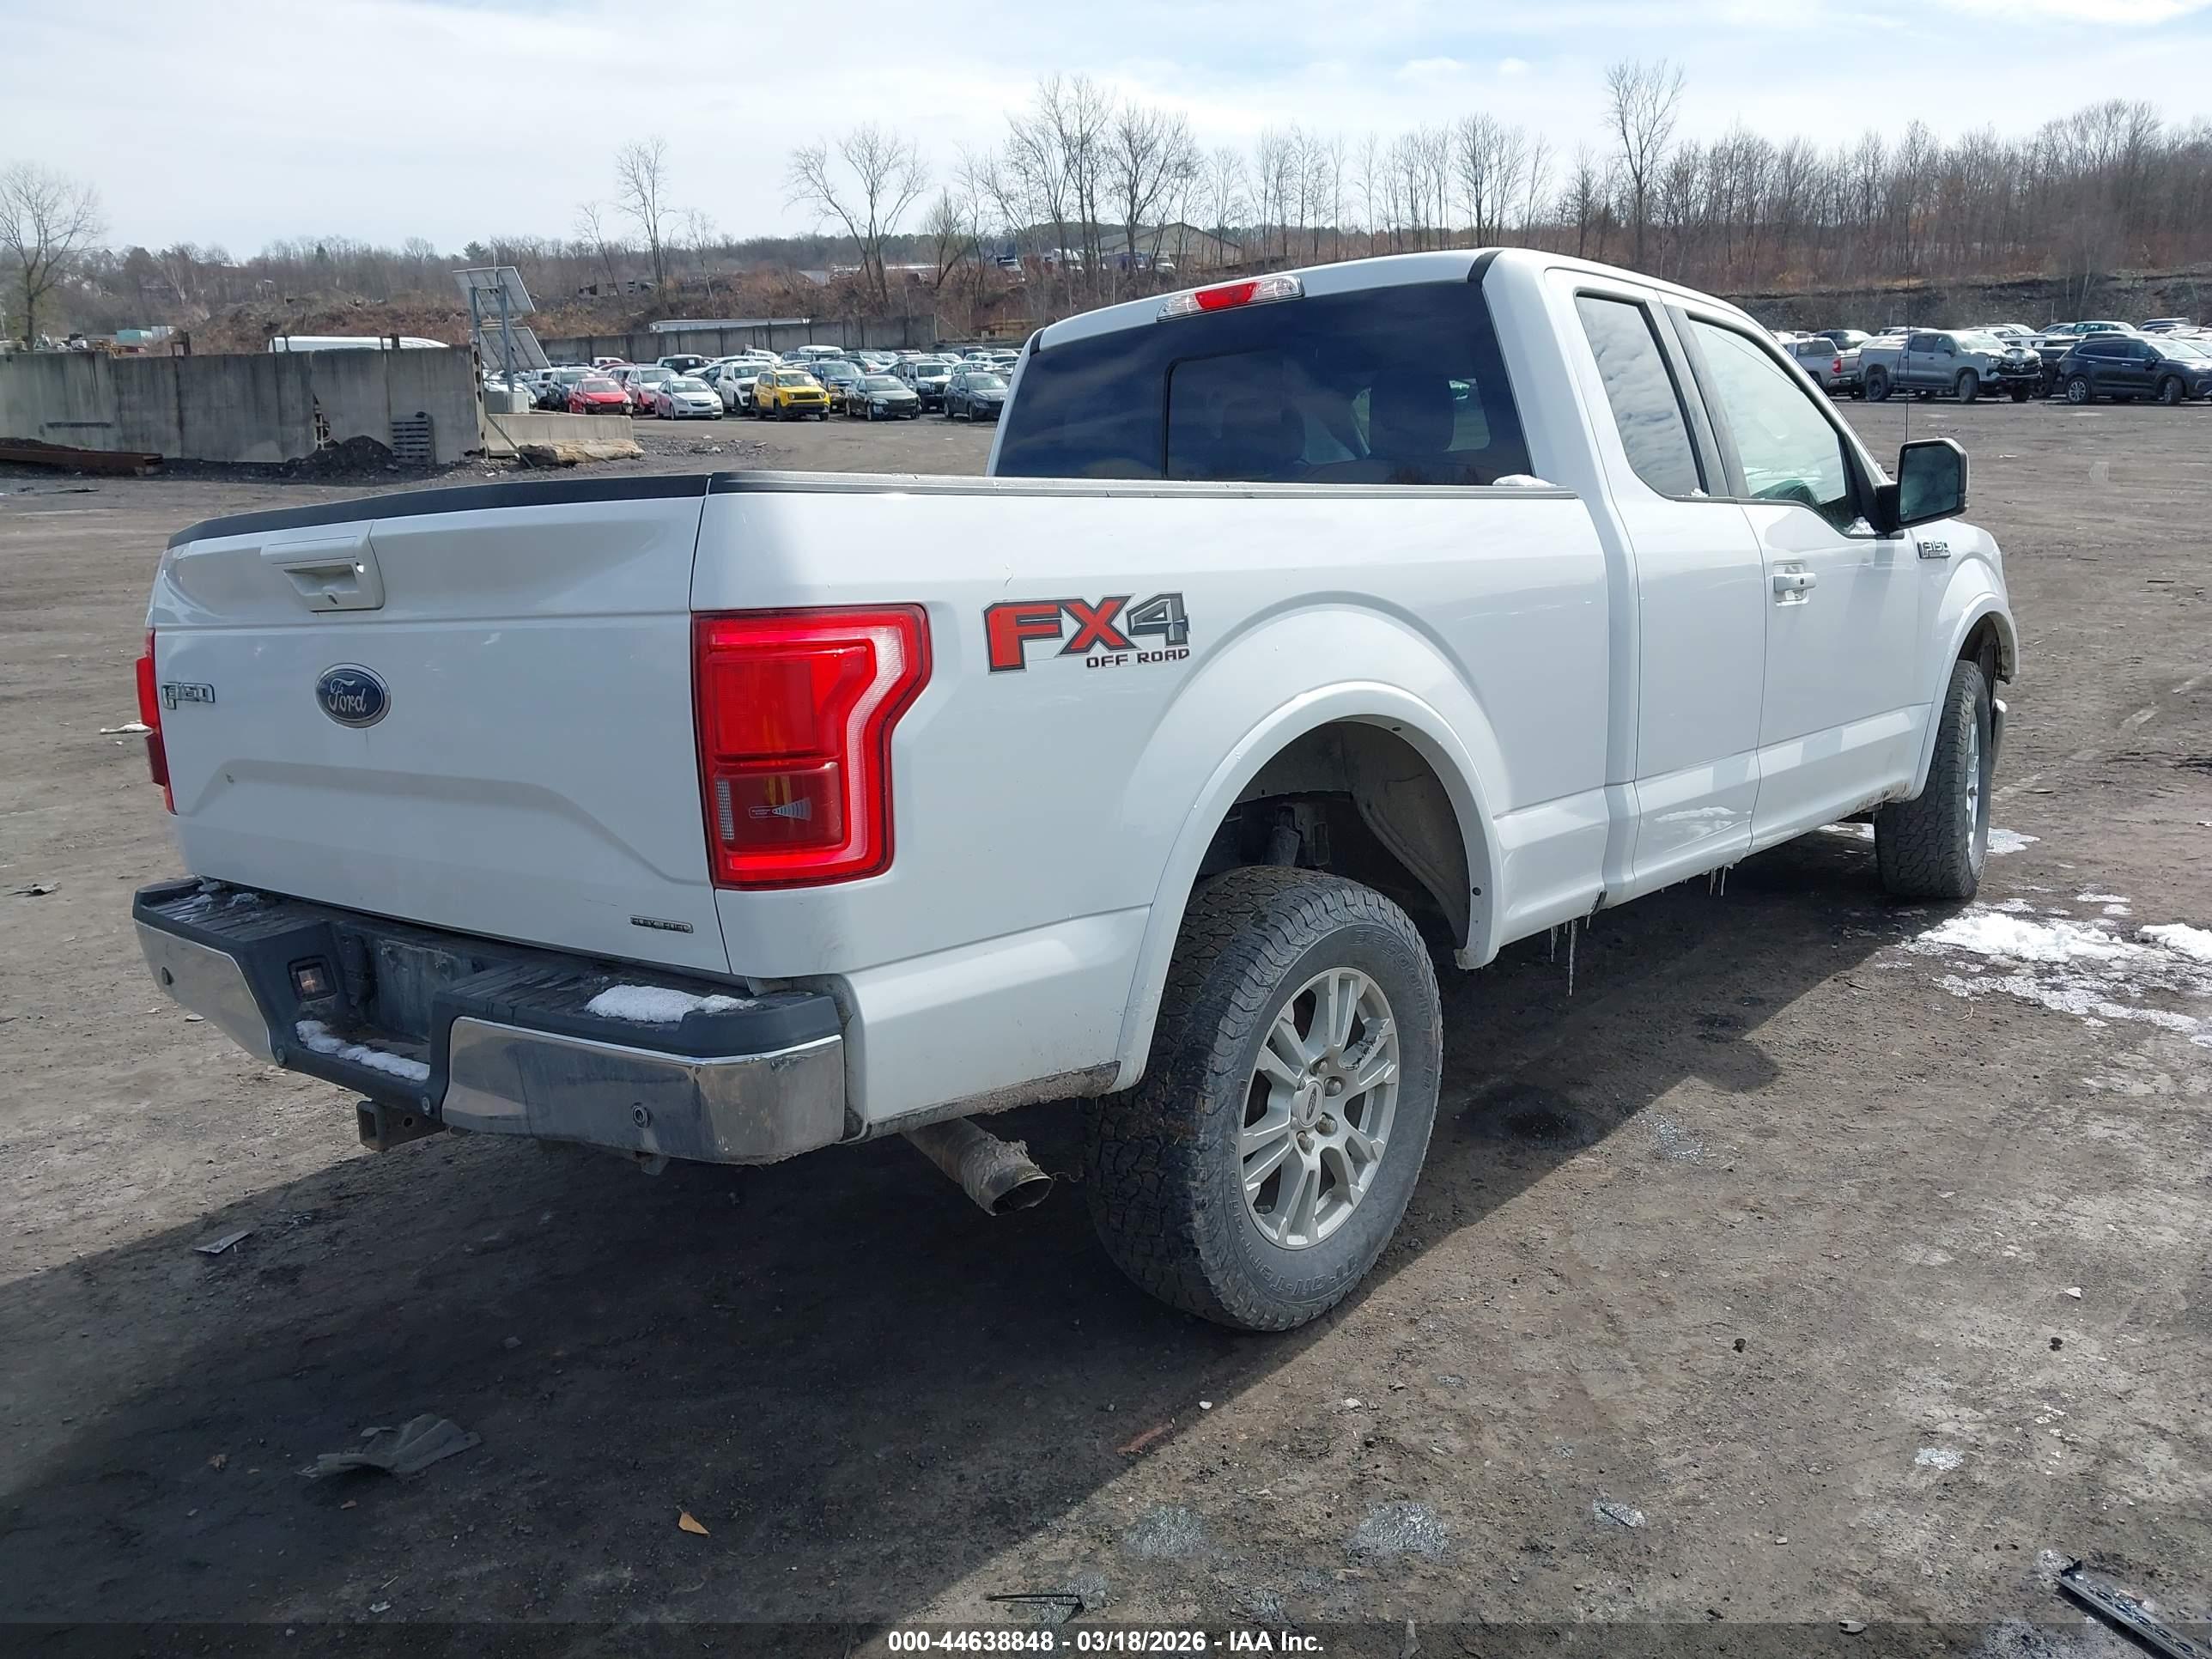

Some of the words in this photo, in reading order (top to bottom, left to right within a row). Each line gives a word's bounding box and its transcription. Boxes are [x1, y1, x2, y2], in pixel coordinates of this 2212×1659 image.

[984, 592, 1188, 672] FX4
[1086, 654, 1129, 669] OFF
[1137, 648, 1190, 664] ROAD
[328, 678, 368, 714] Ford
